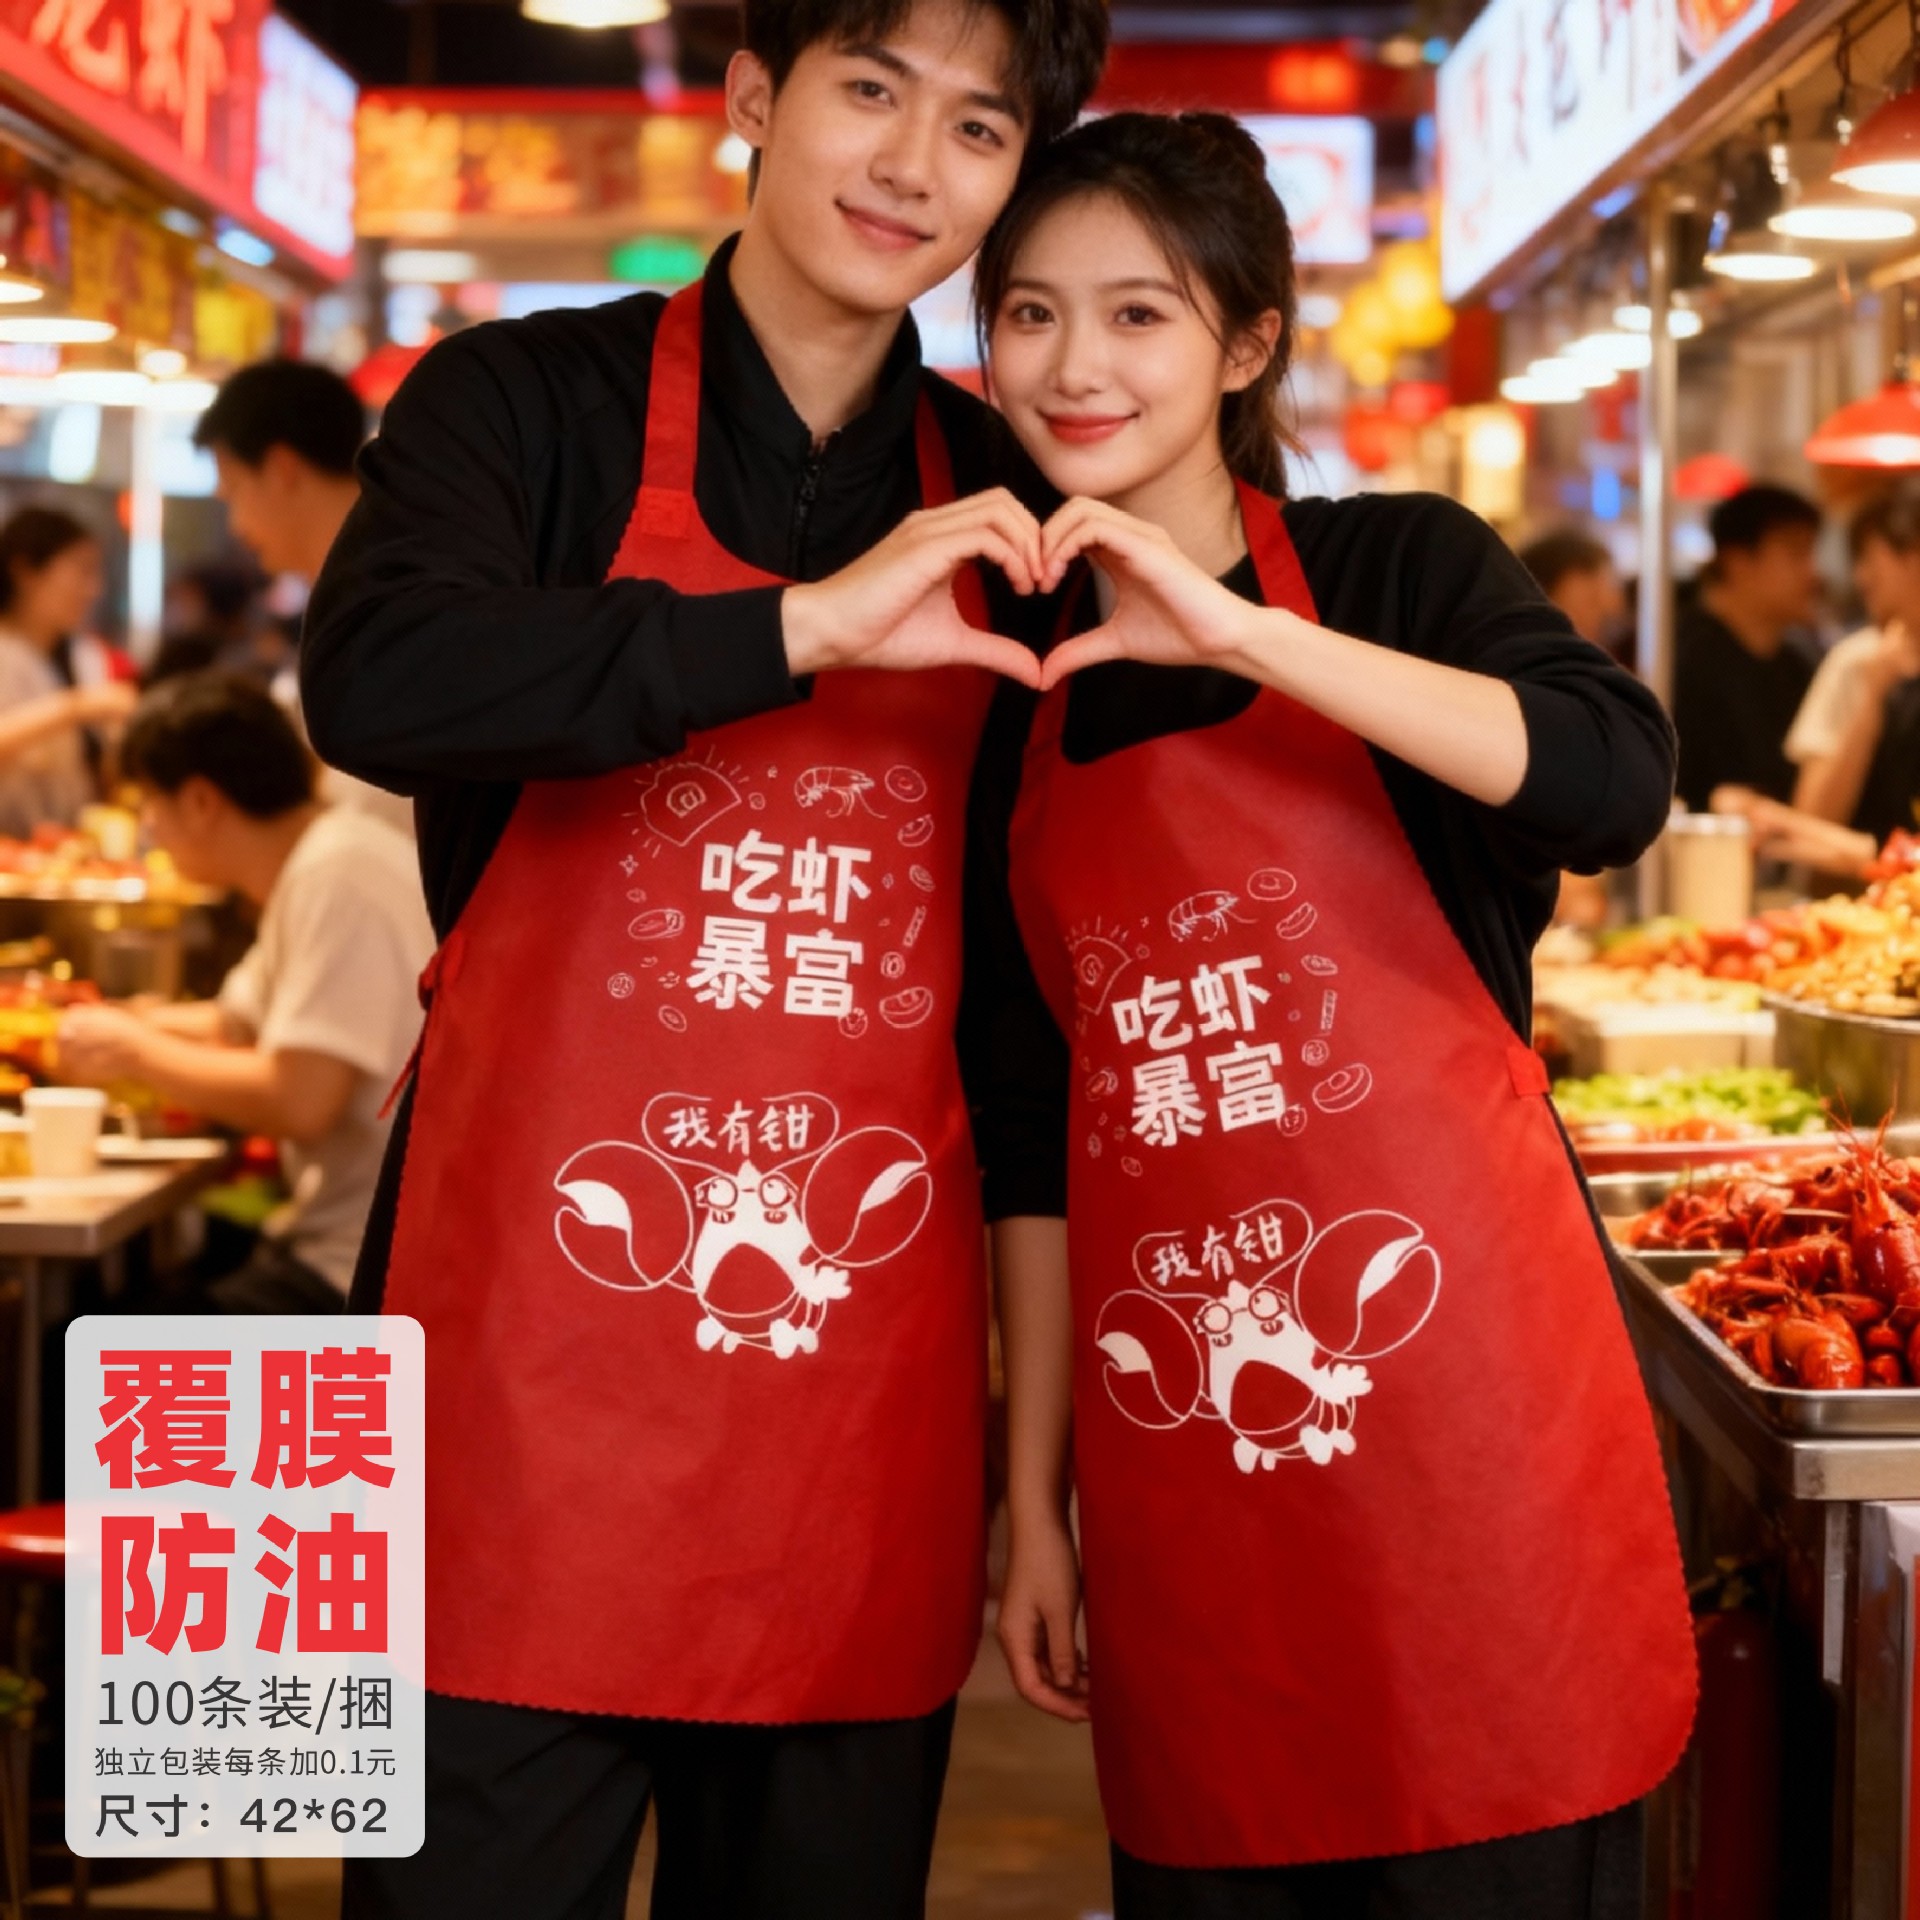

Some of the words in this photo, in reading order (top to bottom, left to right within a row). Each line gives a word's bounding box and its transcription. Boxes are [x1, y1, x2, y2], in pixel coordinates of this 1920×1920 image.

[700, 829, 872, 924] 吃虾
[686, 915, 865, 1017] 暴富
[1111, 955, 1272, 1051] 吃虾
[663, 1100, 816, 1155] 我有钳
[1131, 1040, 1287, 1148] 暴富
[1150, 1211, 1284, 1287] 我有钳
